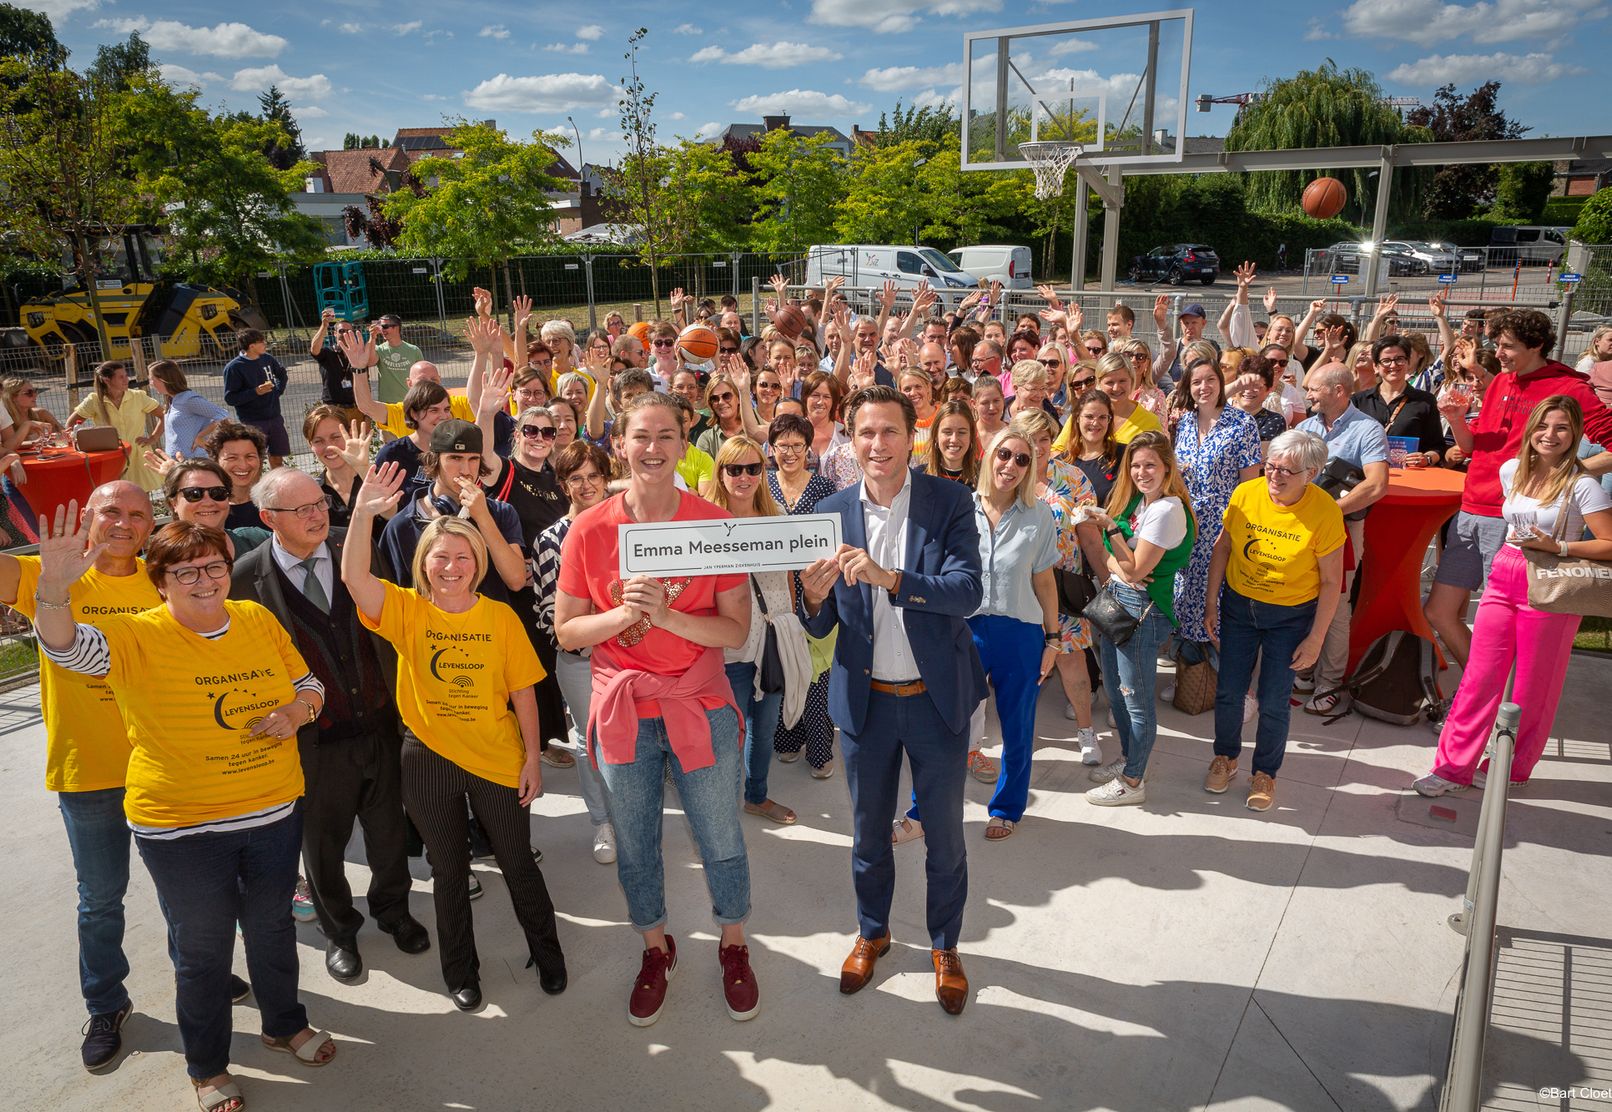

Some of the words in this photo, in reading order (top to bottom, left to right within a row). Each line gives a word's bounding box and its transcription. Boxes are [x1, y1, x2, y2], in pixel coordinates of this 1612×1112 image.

[1245, 522, 1302, 542] ORGANISATIE
[634, 543, 683, 558] Emma
[689, 537, 784, 555] Meesseman
[789, 533, 829, 553] plein
[1249, 548, 1287, 562] LEVENSLOOP
[1535, 566, 1612, 580] FENOME
[82, 606, 151, 615] ORGANISA
[426, 629, 492, 642] ORGANISATIE
[439, 662, 485, 670] LEVENSLOOP
[194, 668, 275, 686] ORGANISATE
[224, 699, 280, 717] LEVENSLOOP
[205, 754, 229, 762] Samen
[228, 759, 247, 768] tegen
